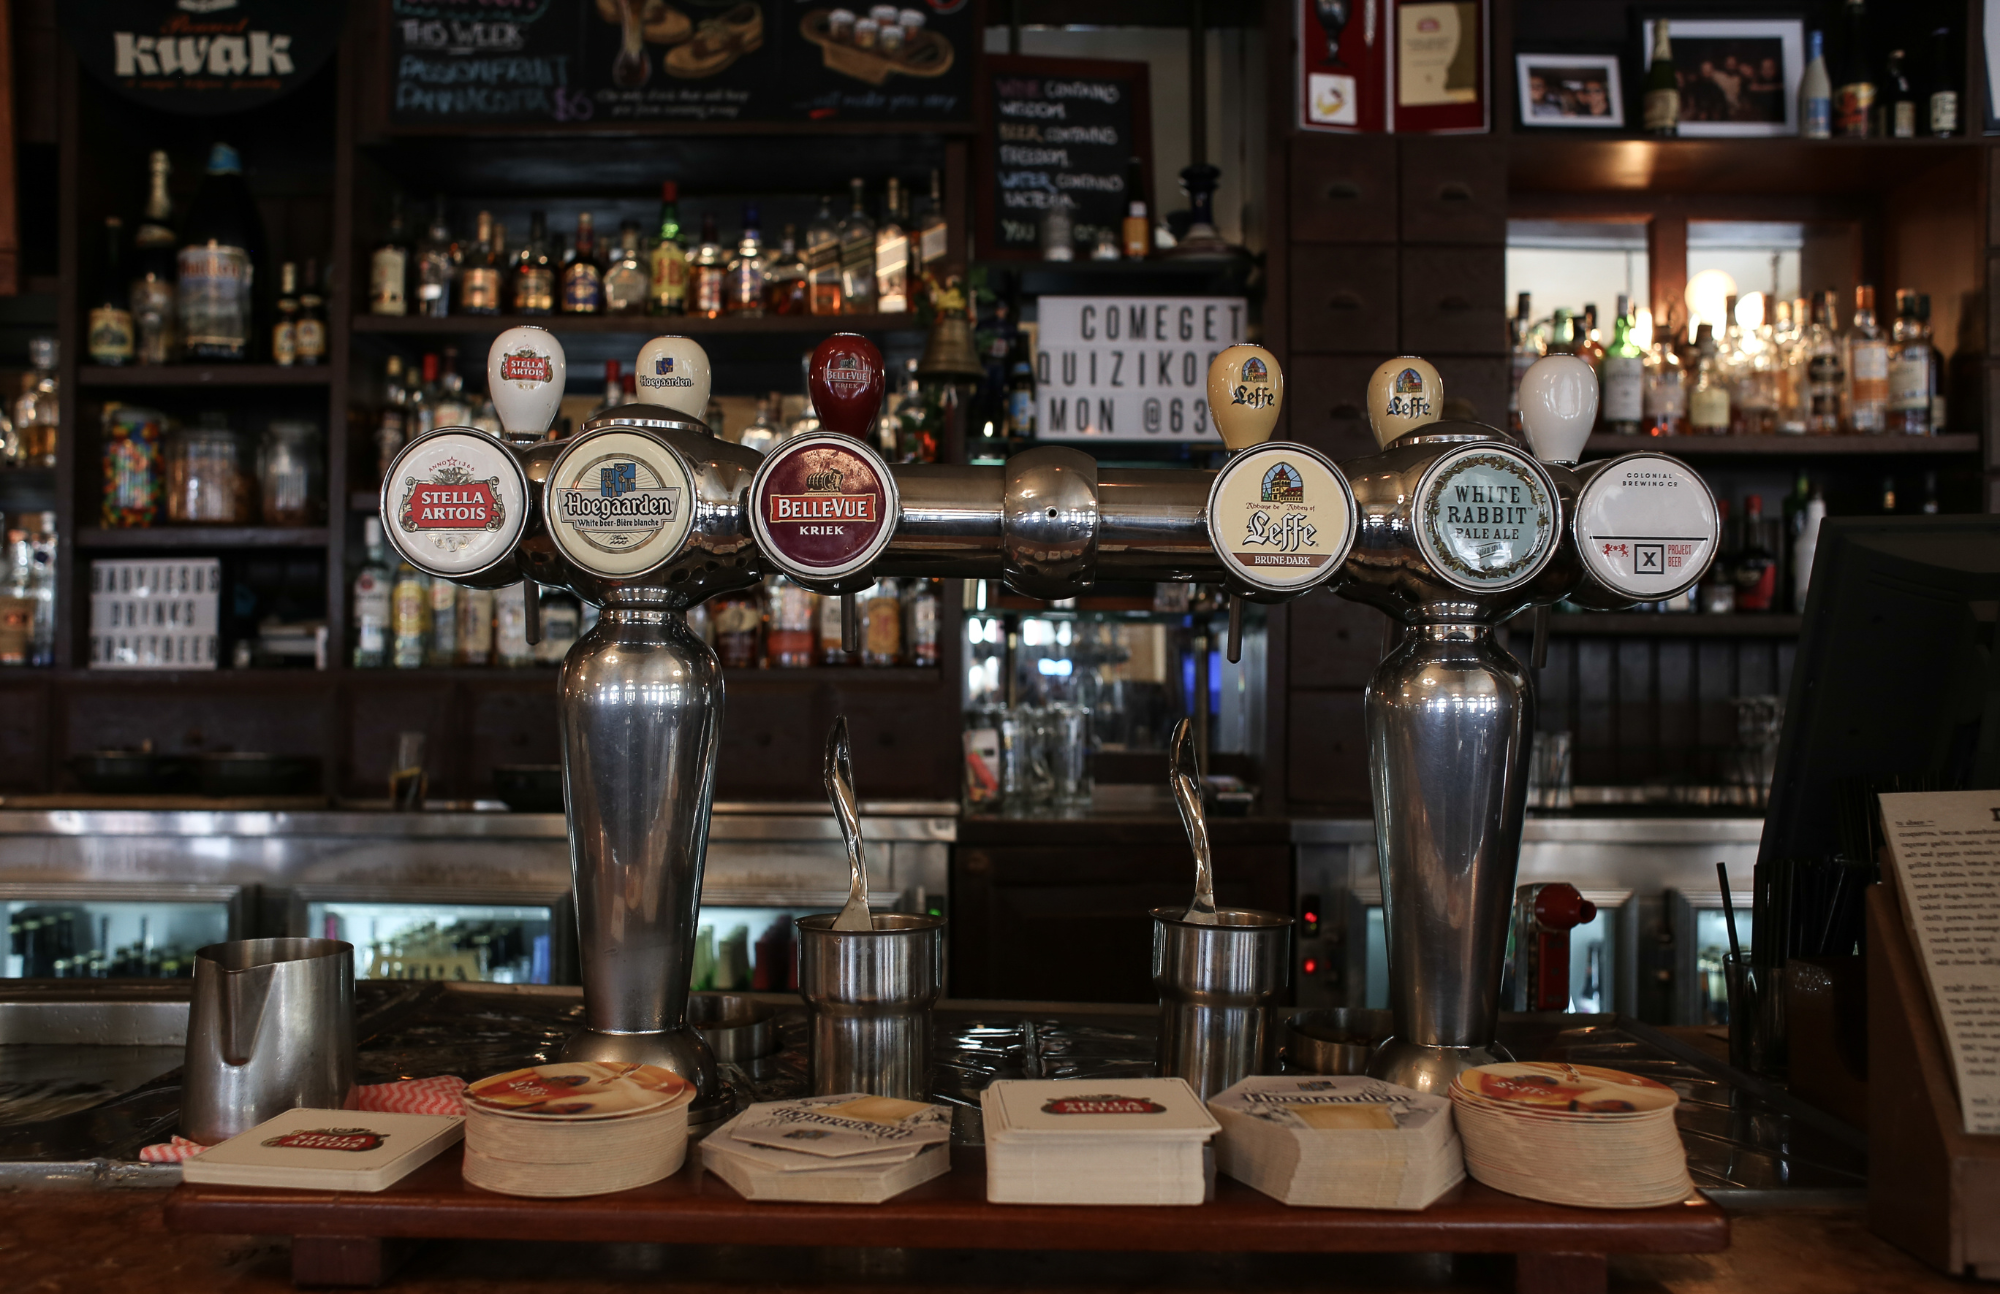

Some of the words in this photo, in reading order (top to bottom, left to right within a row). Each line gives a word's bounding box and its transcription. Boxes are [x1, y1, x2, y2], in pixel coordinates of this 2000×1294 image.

[397, 19, 448, 46] THIS
[451, 20, 524, 47] WEEK
[113, 30, 295, 77] kwak
[511, 359, 543, 368] STELLA
[511, 367, 544, 376] ARTOIS
[826, 370, 867, 381] BELLE-VUE
[640, 375, 692, 389] Hoegaarden
[1231, 385, 1274, 410] Leffe
[1050, 397, 1114, 433] MON
[1386, 396, 1431, 420] Leffe
[428, 460, 447, 472] ANNO
[421, 491, 485, 505] STELLA
[1454, 485, 1520, 504] WHITE
[563, 491, 672, 520] Hoegaarden
[778, 498, 868, 518] BELLE-VUE
[1286, 503, 1308, 511] Abbey
[421, 507, 487, 521] ARTOIS
[1447, 506, 1527, 524] RABBIT
[577, 519, 599, 527] White
[633, 518, 659, 527] blanche
[799, 526, 844, 535] KRIEK
[1242, 510, 1317, 552] Leffe
[1455, 528, 1489, 539] PALE
[1493, 528, 1519, 540] ALE
[1668, 544, 1692, 555] PROJECT
[1642, 552, 1656, 567] X
[1668, 556, 1682, 568] BEER
[283, 1139, 361, 1149] ARTOIS
[296, 1134, 367, 1143] STELLA
